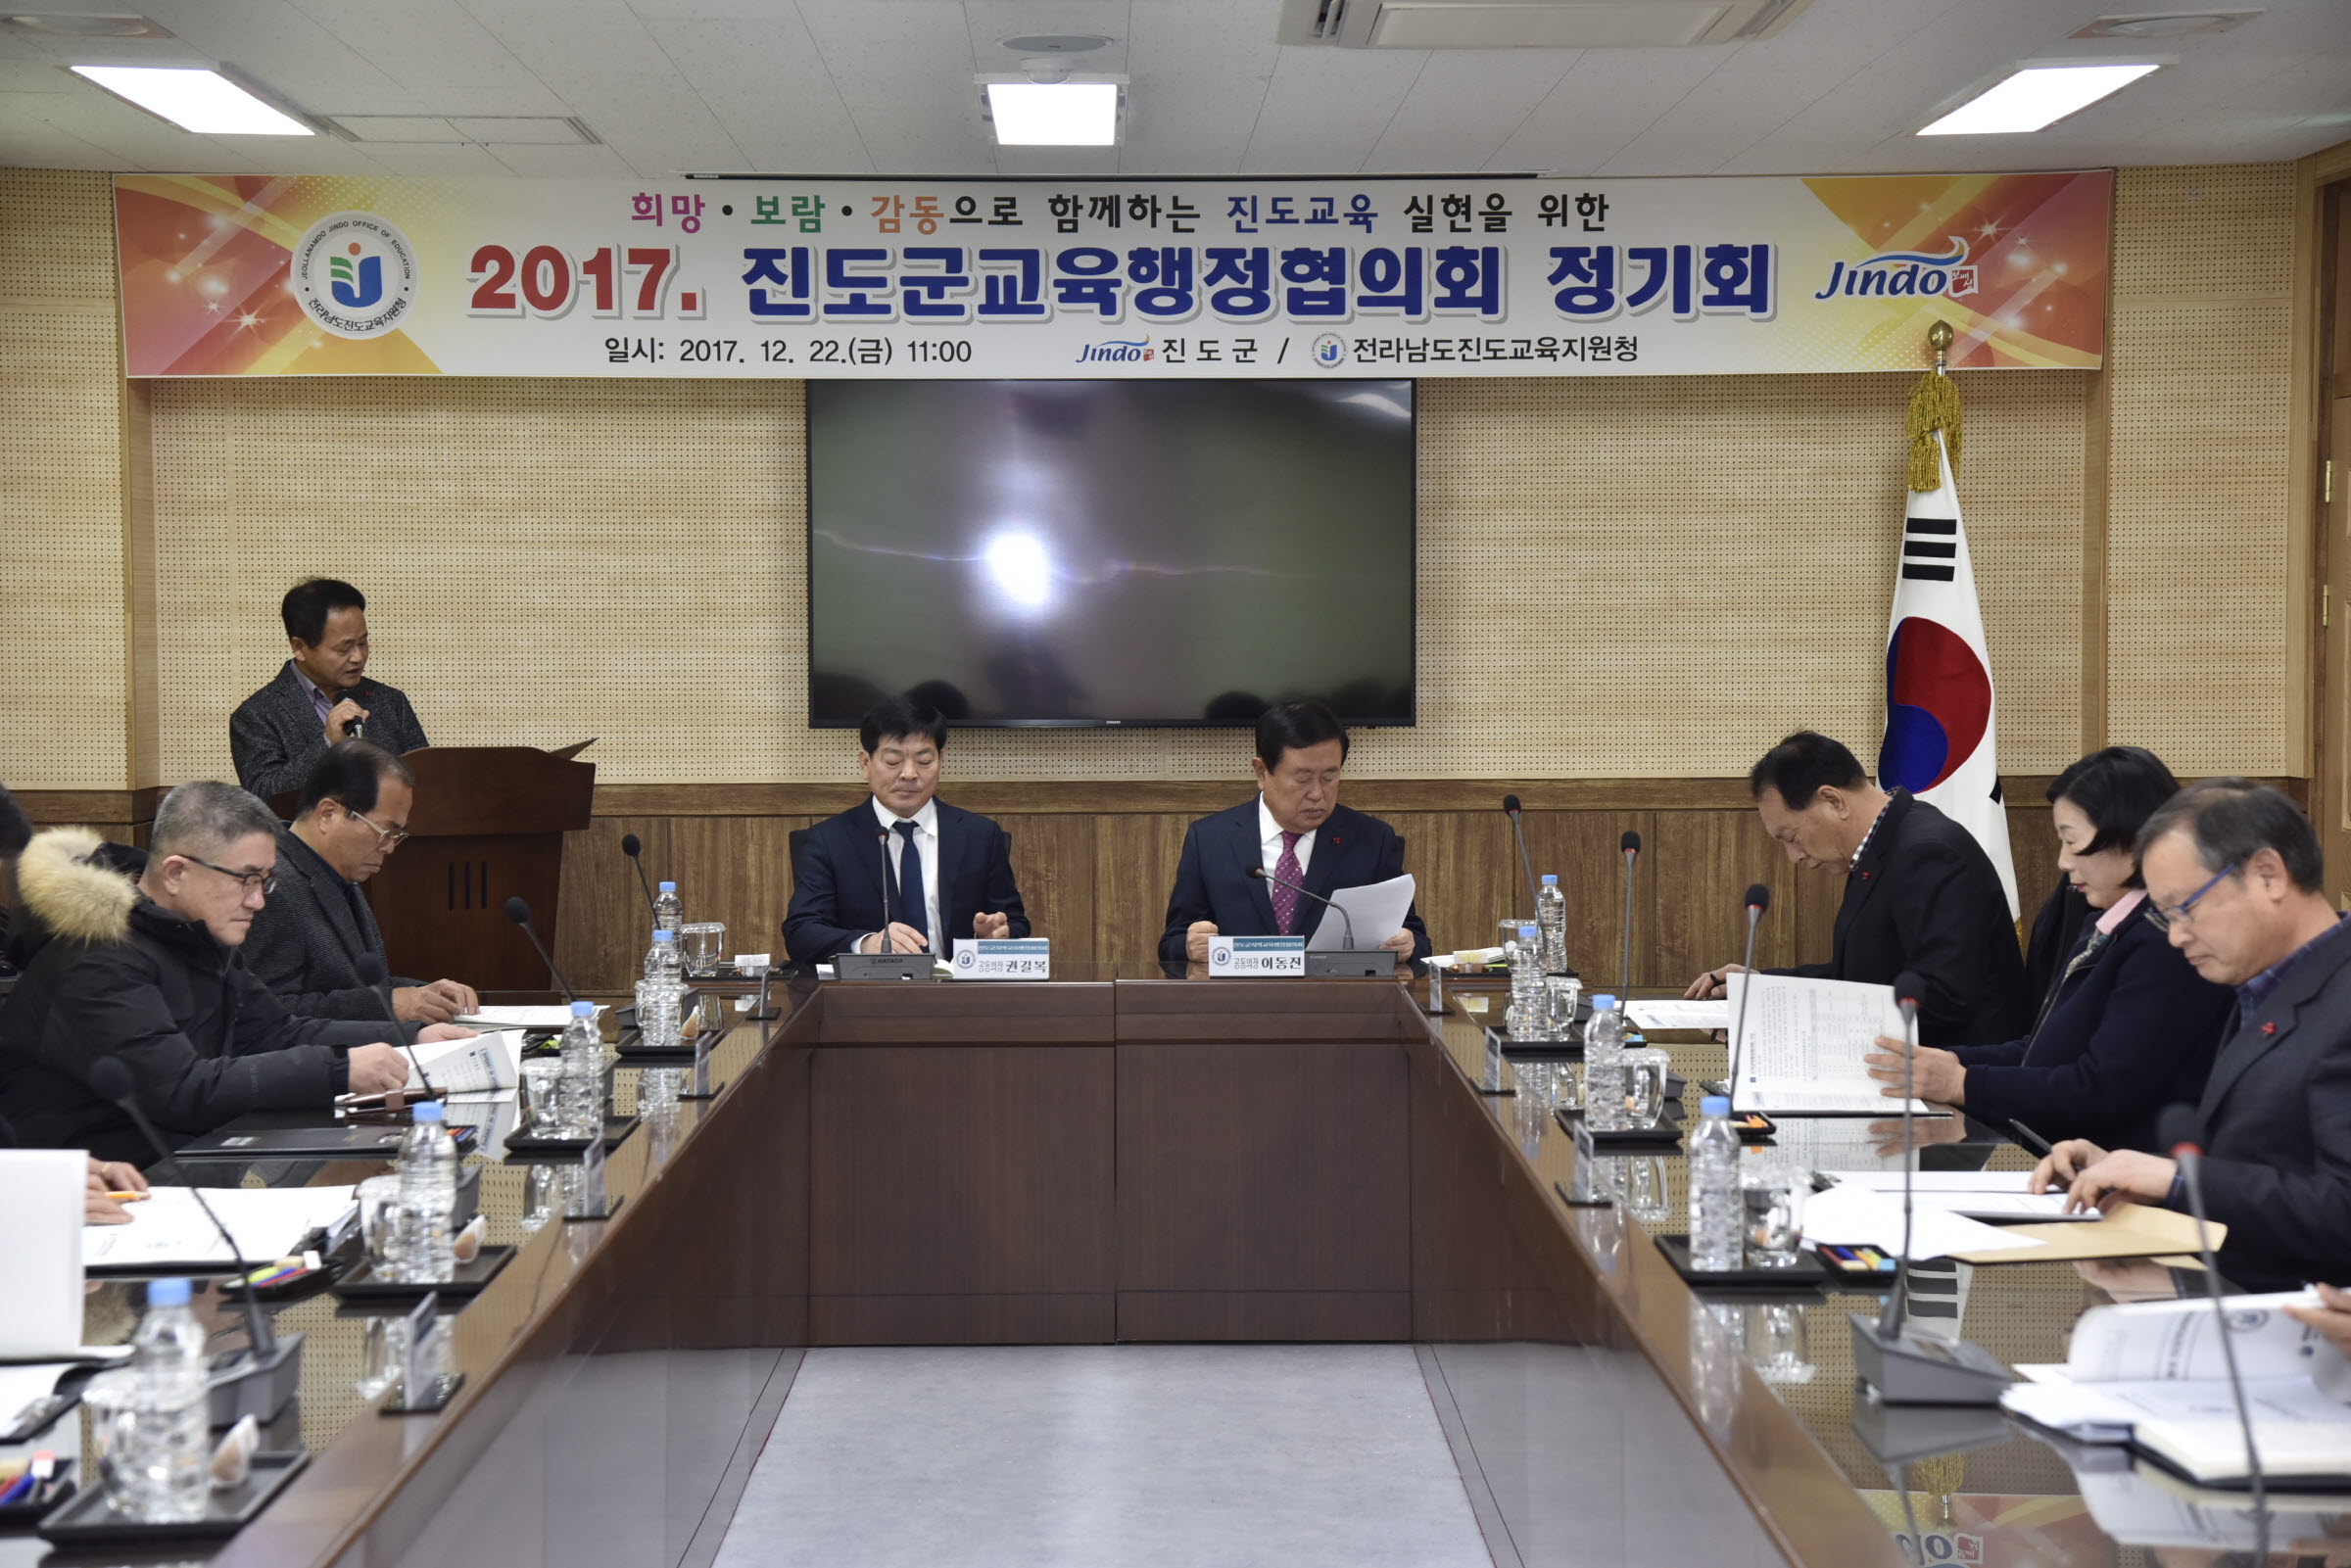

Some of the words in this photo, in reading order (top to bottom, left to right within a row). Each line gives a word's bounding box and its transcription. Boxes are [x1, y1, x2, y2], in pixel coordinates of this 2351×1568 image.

[631, 191, 706, 234] 희망
[750, 194, 826, 234] 보람
[870, 195, 1024, 235] 감동으로
[1047, 193, 1201, 234] 함께하는
[1226, 193, 1379, 234] 진도교육
[1403, 192, 1513, 234] 실현을
[1537, 192, 1610, 232] 위한
[301, 230, 327, 280] JEOLLANAMDO
[328, 220, 350, 233] JINDO
[352, 220, 379, 232] OFFICE
[380, 229, 392, 239] OF
[391, 239, 411, 280] EDUCATION
[470, 244, 698, 312] 2017.
[742, 246, 1501, 317] 진도군교육행정협의회
[1547, 243, 1770, 315] 정기회
[1815, 261, 1947, 300] Jindo
[309, 297, 407, 332] 전라남도진도교육지원청
[604, 336, 664, 364] 일시:
[679, 338, 745, 364] 2017.
[760, 339, 794, 364] 12.
[809, 336, 893, 366] 22.(금)
[907, 339, 973, 364] 11:00
[1076, 344, 1141, 363] Jindo
[1352, 335, 1638, 364] 전라남도진도교육지원청
[1261, 956, 1302, 970] 이동진
